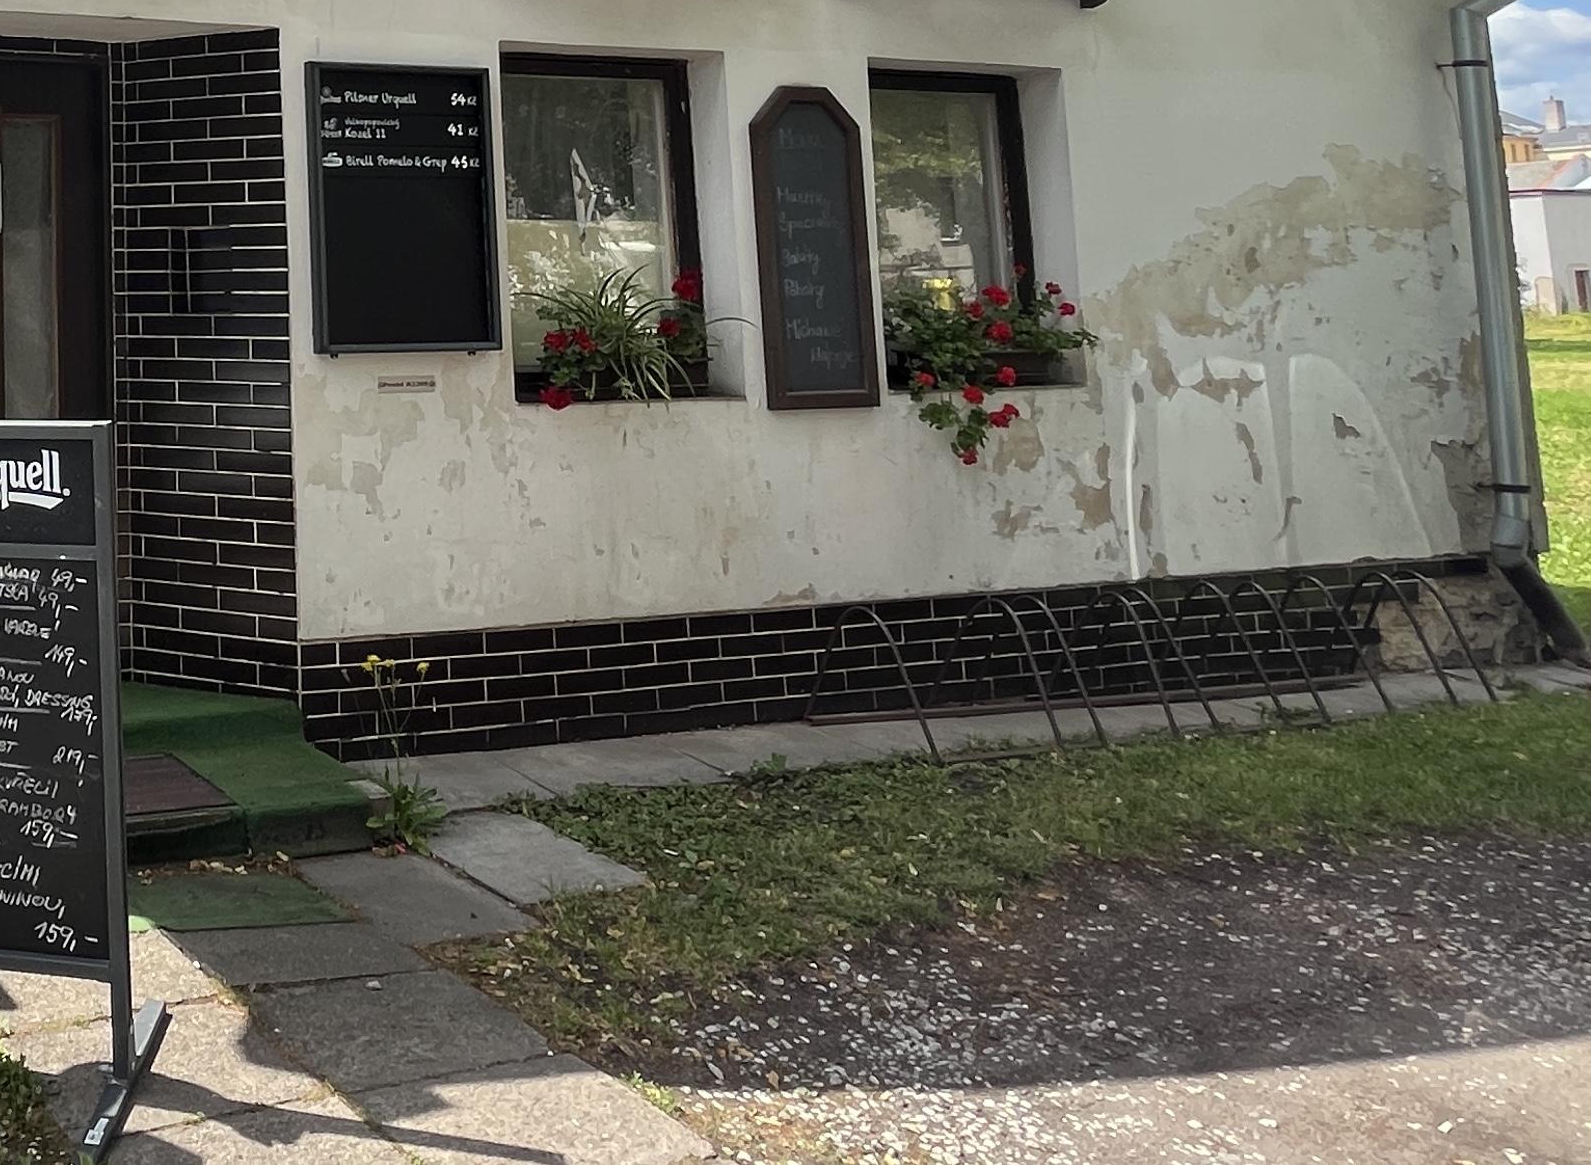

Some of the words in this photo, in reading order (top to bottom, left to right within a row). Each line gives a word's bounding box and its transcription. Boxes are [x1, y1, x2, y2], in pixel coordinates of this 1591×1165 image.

[344, 91, 379, 104] Pilsner
[381, 92, 417, 109] Urquell
[450, 92, 466, 106] 54
[345, 127, 372, 139] Kozel
[375, 128, 386, 139] 11
[447, 123, 464, 136] 41
[345, 154, 374, 167] Birell
[376, 154, 414, 167] Pomelo
[451, 155, 468, 169] 45
